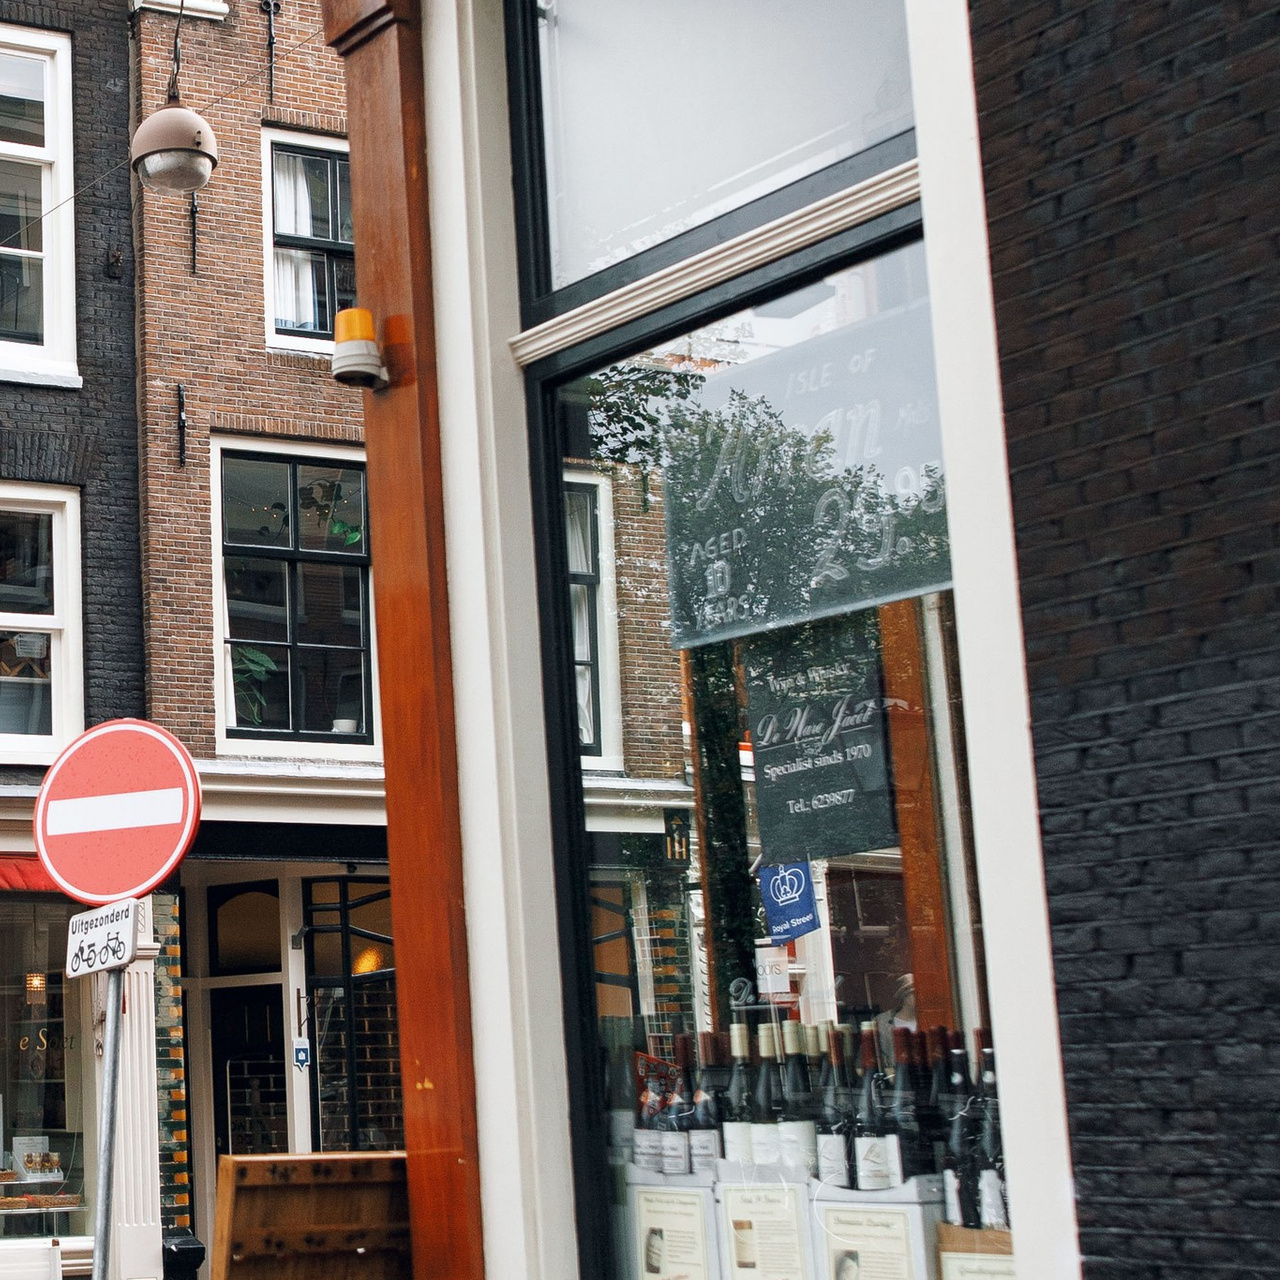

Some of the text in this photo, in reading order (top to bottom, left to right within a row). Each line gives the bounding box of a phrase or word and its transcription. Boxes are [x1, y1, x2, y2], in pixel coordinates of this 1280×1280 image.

[689, 527, 748, 566] AGED
[763, 744, 871, 782] Specialist sinds 1970
[71, 900, 131, 935] Uitgezonderd
[772, 920, 791, 934] Royal
